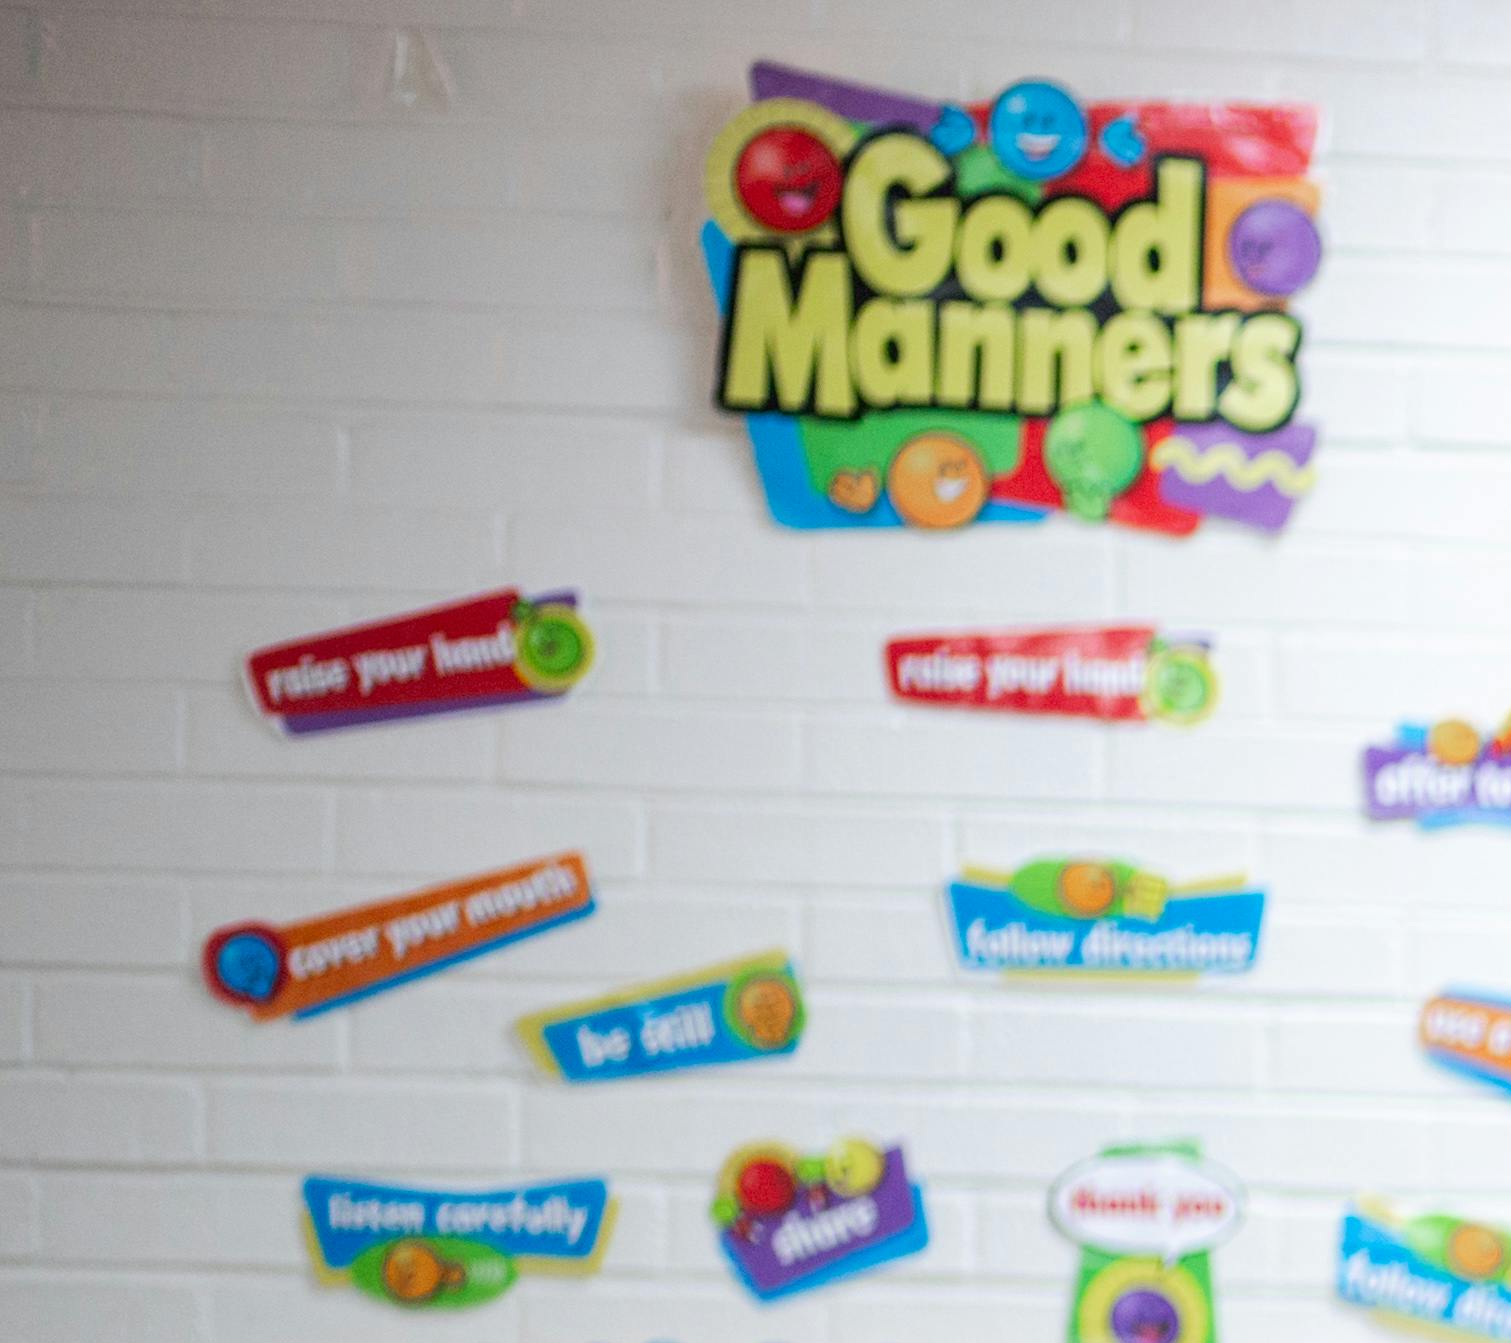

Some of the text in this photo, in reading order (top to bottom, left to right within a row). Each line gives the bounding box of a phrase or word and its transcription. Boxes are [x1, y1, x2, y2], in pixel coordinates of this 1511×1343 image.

[845, 130, 1207, 312] Good
[725, 250, 1302, 430] Manners
[266, 624, 514, 701] raise your hand
[902, 648, 1146, 699] raise your hand
[1374, 754, 1471, 805] offer
[289, 862, 576, 979] cover your mouth
[966, 917, 1253, 966] follow directions
[576, 1000, 714, 1068] be still
[329, 1196, 590, 1246] listen carefully
[770, 1197, 879, 1268] share
[1071, 1185, 1224, 1222] thank you
[1344, 1248, 1450, 1310] follow
